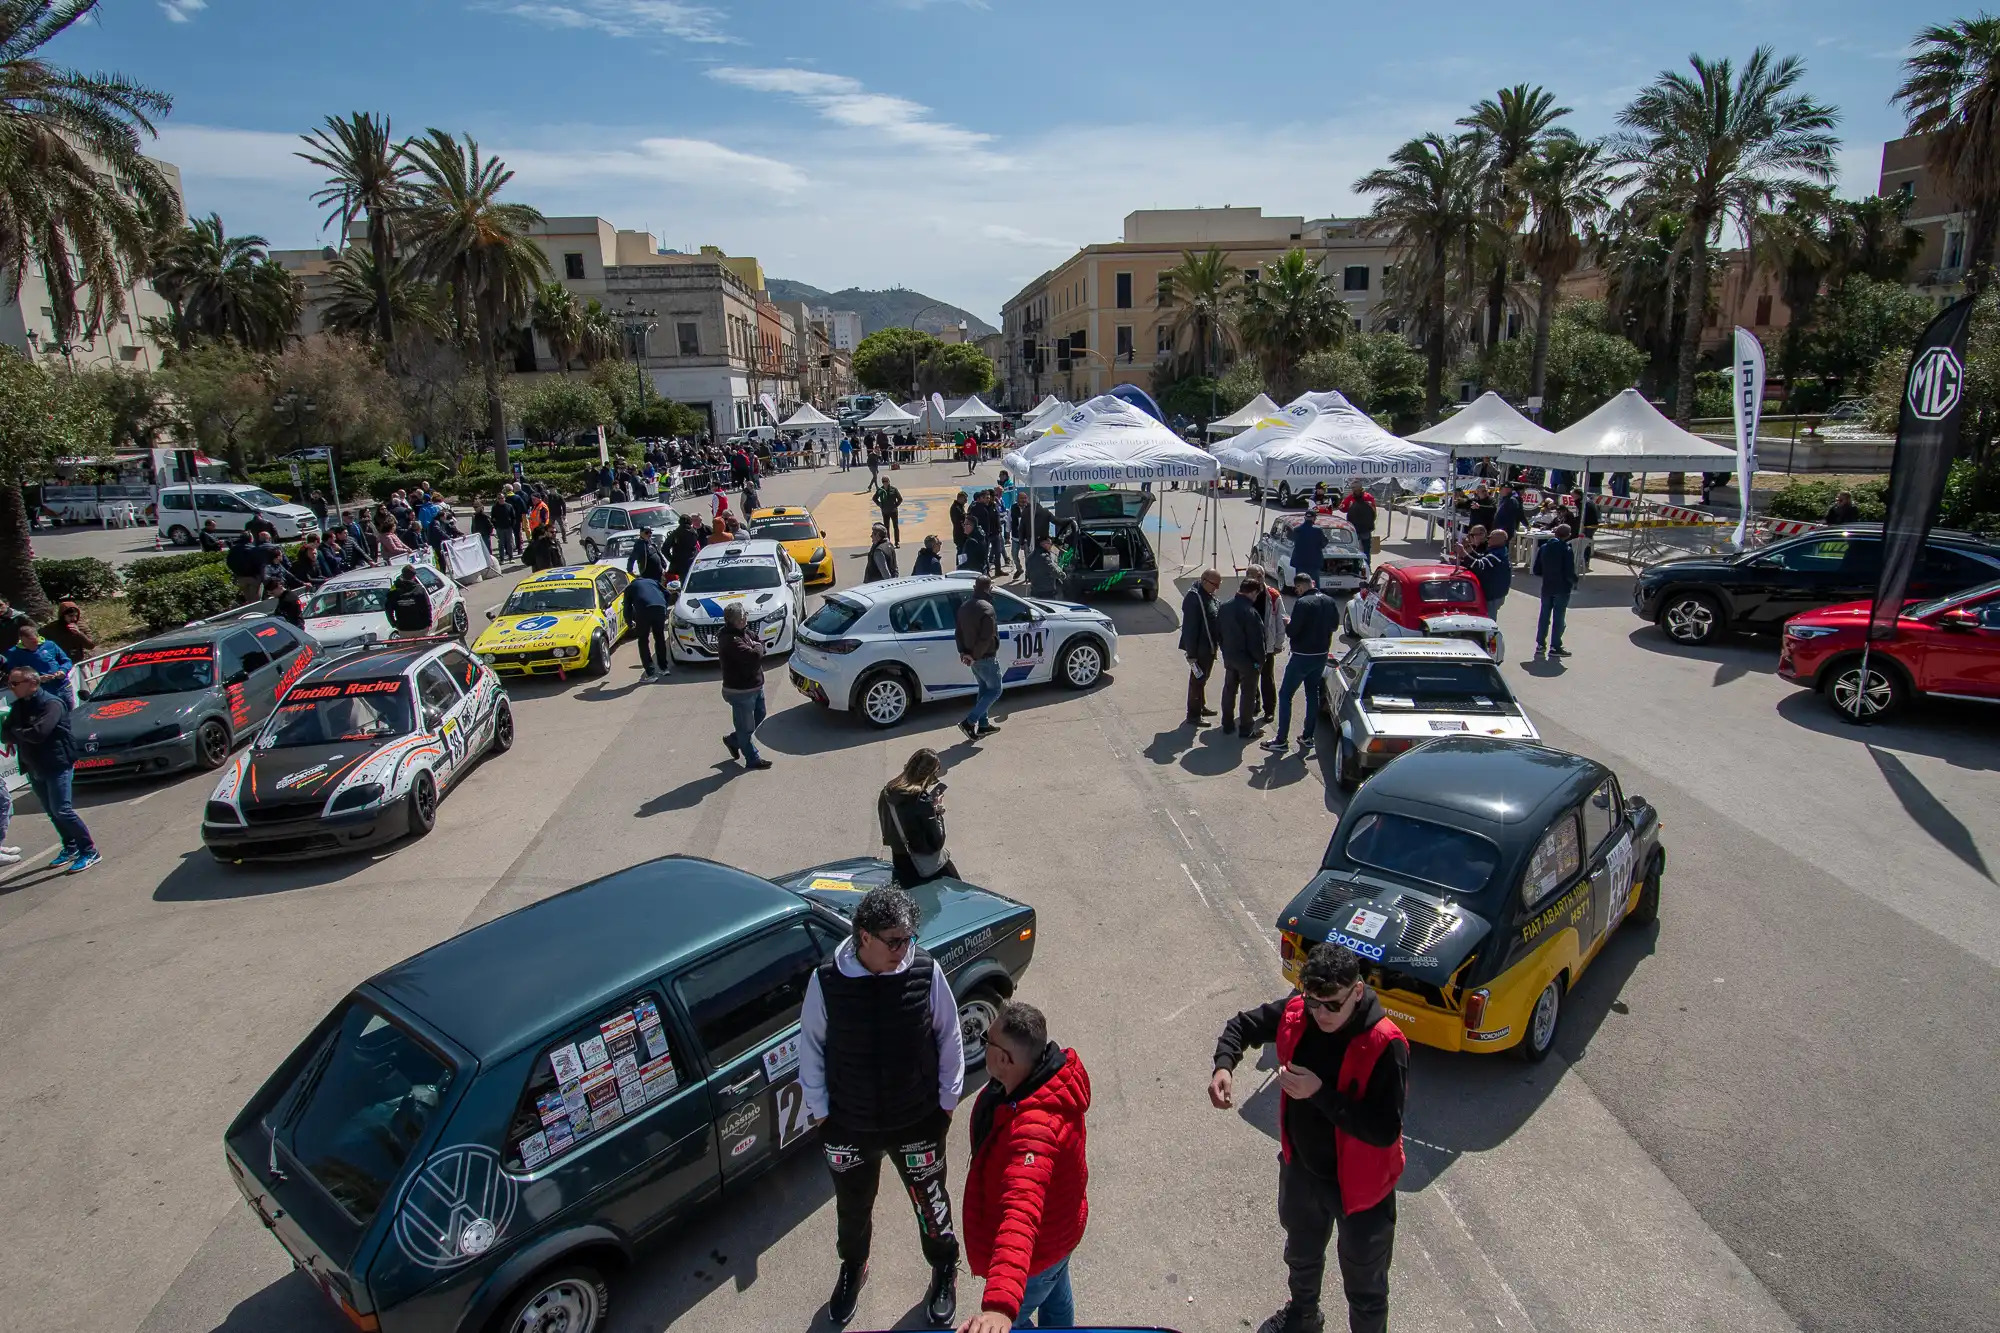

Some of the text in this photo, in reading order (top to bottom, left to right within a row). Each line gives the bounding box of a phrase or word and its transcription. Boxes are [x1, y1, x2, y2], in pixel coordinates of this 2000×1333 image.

[1911, 353, 1958, 414] MG
[1050, 464, 1200, 482] Automobile Club d'Italia
[1286, 460, 1432, 476] Automobile Club d'Italia
[1563, 495, 1576, 507] BE
[130, 648, 190, 662] Peugeot
[489, 643, 526, 652] FIFTEEN
[1013, 631, 1044, 660] 104
[274, 644, 314, 702] MASCARELLA
[288, 680, 401, 701] Tintillo Racing
[1522, 917, 1541, 943] FIAT
[1543, 891, 1573, 929] ABARTH
[964, 927, 992, 951] Piazza
[1327, 930, 1383, 959] sparco
[1480, 1026, 1510, 1040] YOKOHAMA
[721, 1106, 760, 1137] MASSIMO
[734, 1137, 753, 1153] BELL
